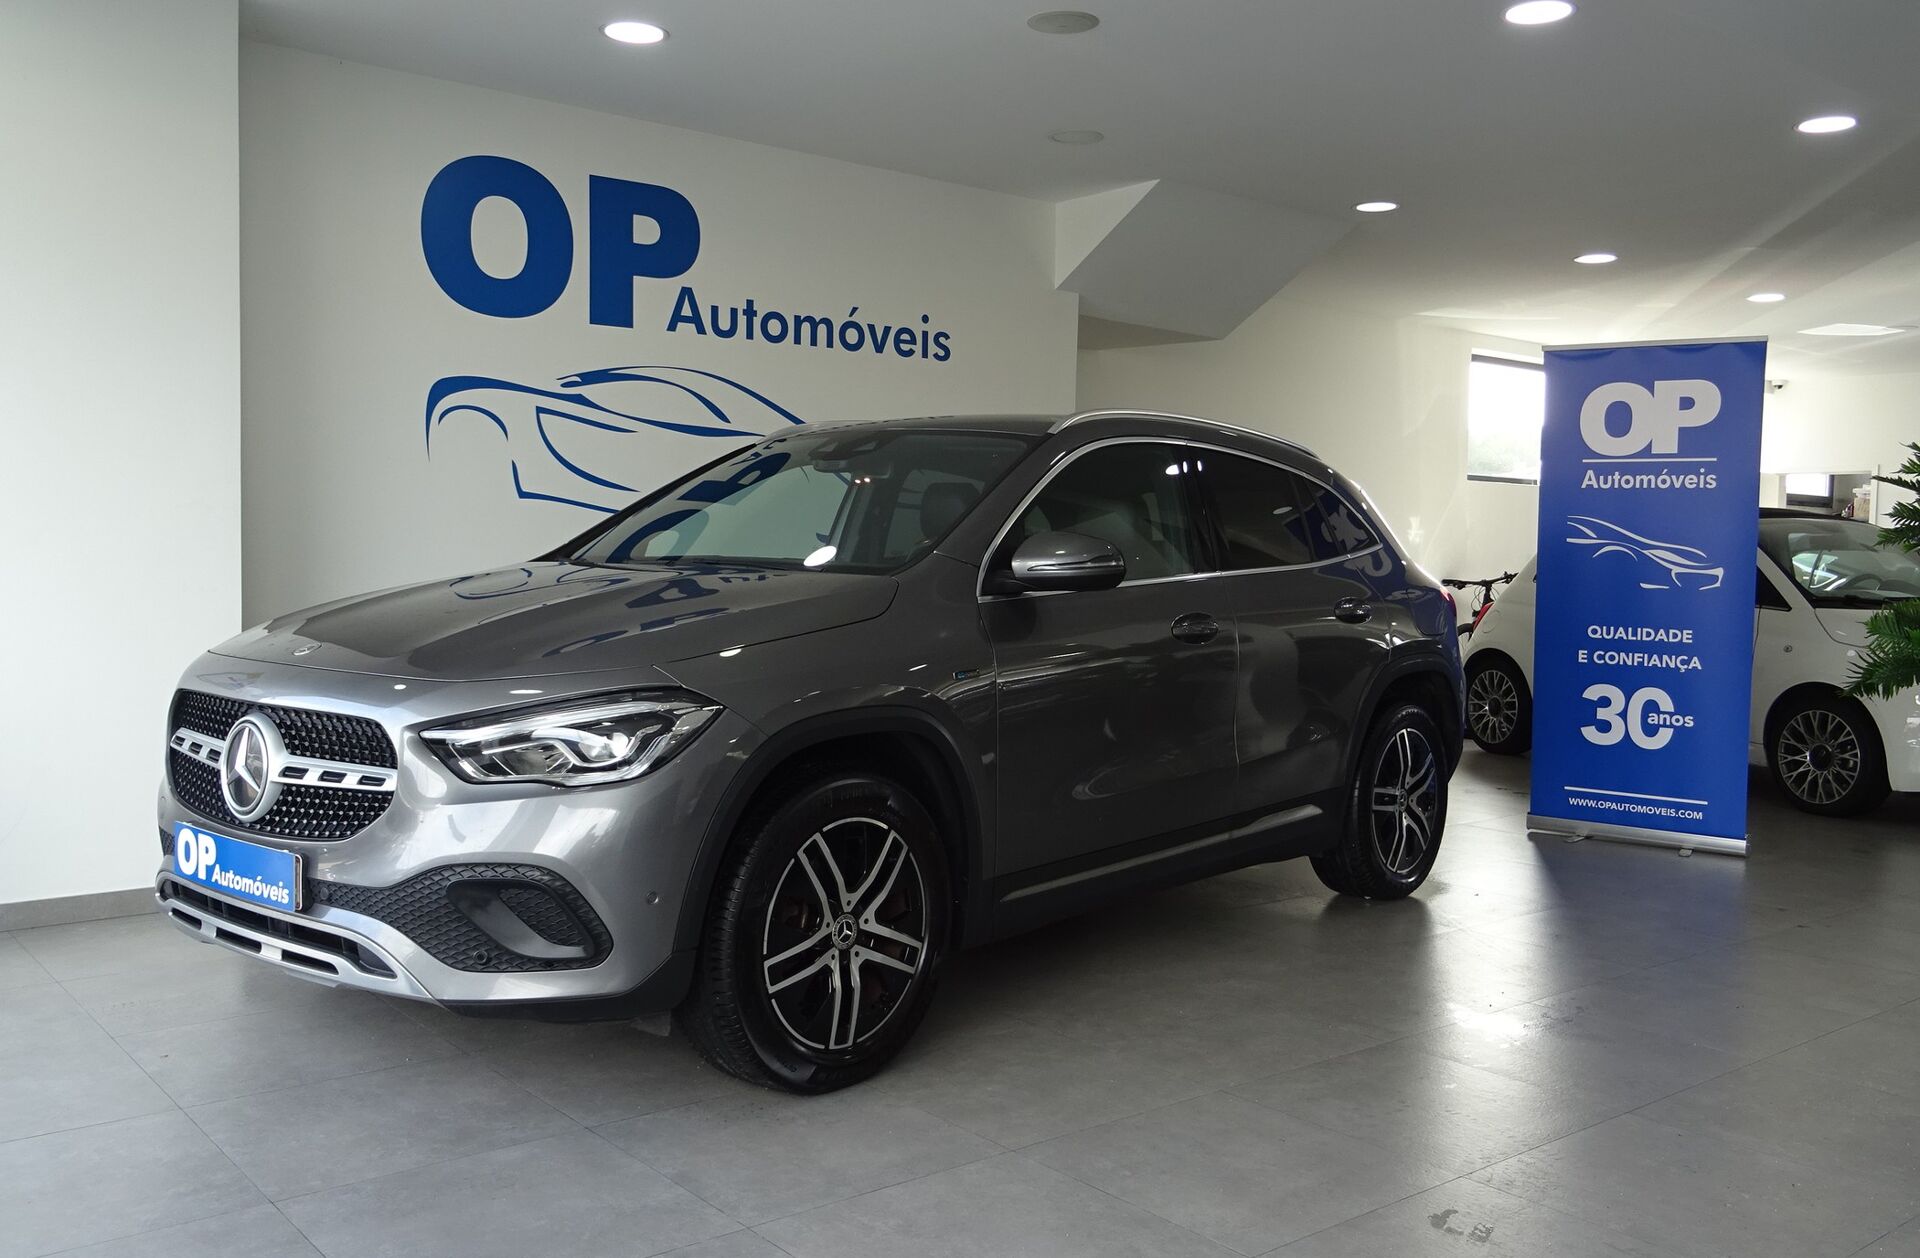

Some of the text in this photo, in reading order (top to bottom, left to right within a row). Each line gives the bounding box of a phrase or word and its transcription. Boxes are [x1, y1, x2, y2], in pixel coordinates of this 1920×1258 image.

[421, 155, 952, 362] OP Automóveis
[1579, 379, 1722, 457] OP
[1581, 467, 1717, 489] Automóveis
[1587, 625, 1693, 643] QUALIDADE
[1578, 650, 1702, 673] E CONFIANÇA
[1580, 683, 1694, 750] 30 anos
[1568, 797, 1703, 820] WWW.OPAUTOMOVEIS.COM
[177, 828, 290, 904] OP Automóveis
